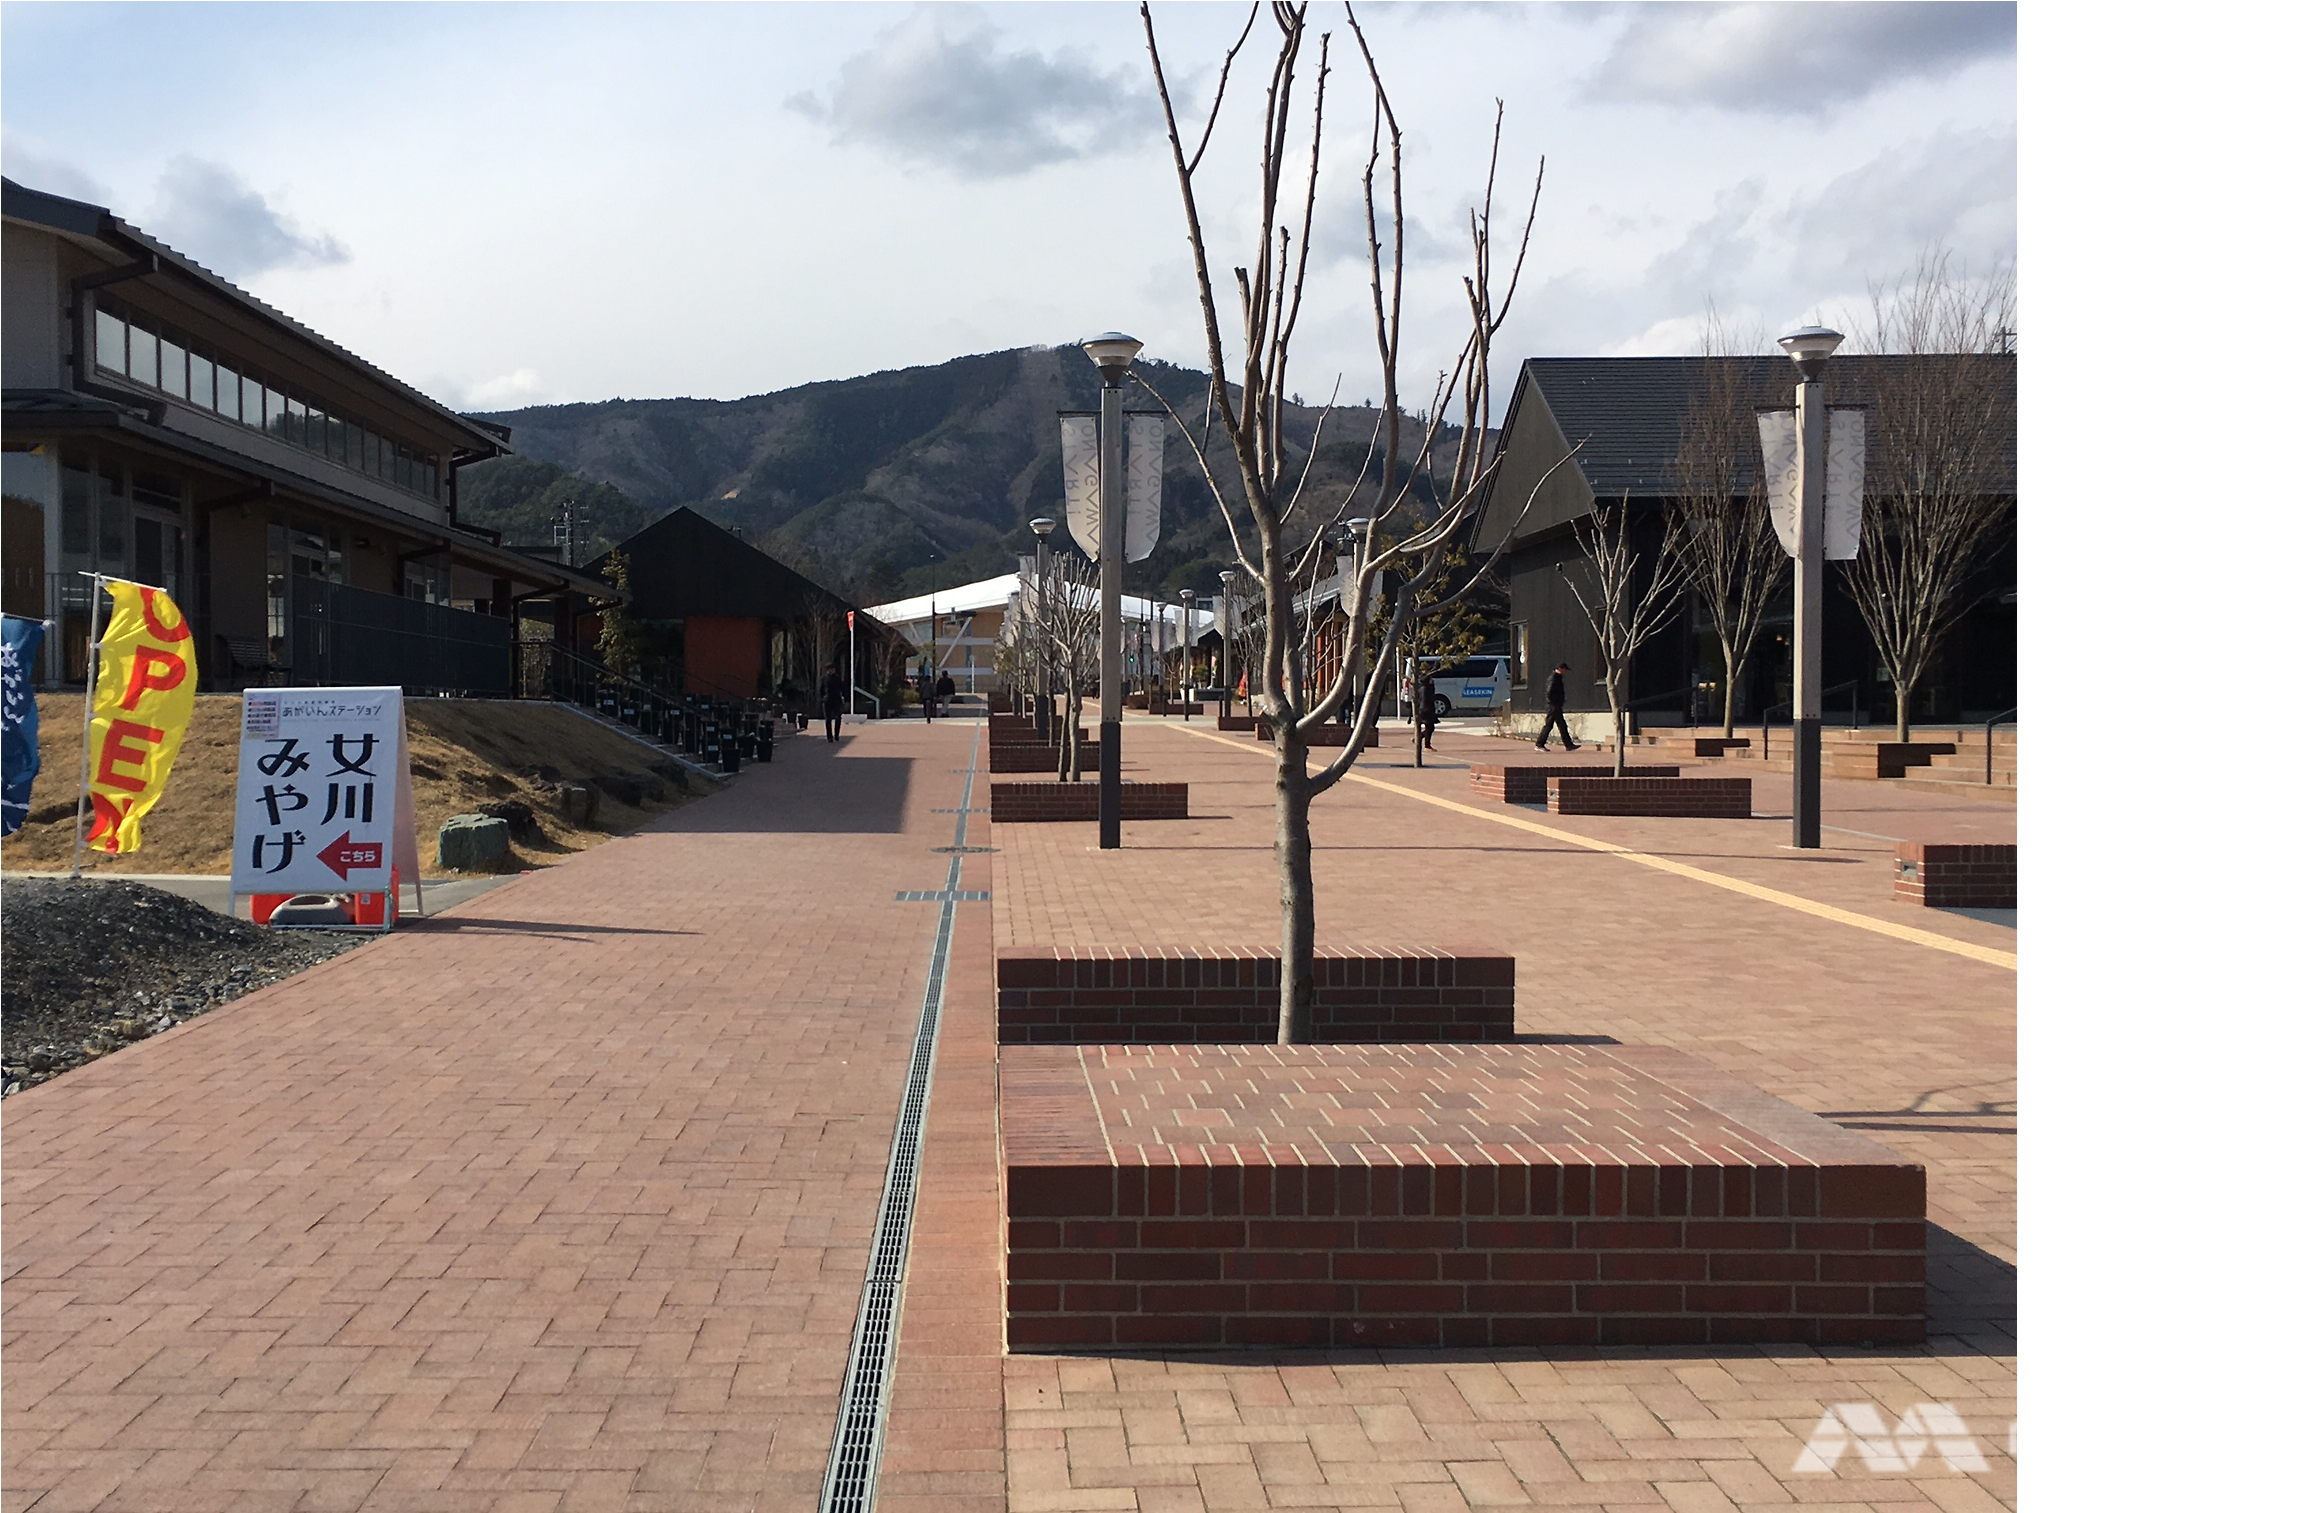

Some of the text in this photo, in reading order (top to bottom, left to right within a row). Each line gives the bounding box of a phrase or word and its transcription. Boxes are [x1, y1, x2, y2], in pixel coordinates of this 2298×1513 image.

[282, 705, 382, 717] あがいんステーション
[252, 738, 310, 874] みやげ
[321, 733, 380, 826] 女川
[340, 850, 376, 863] こちら
